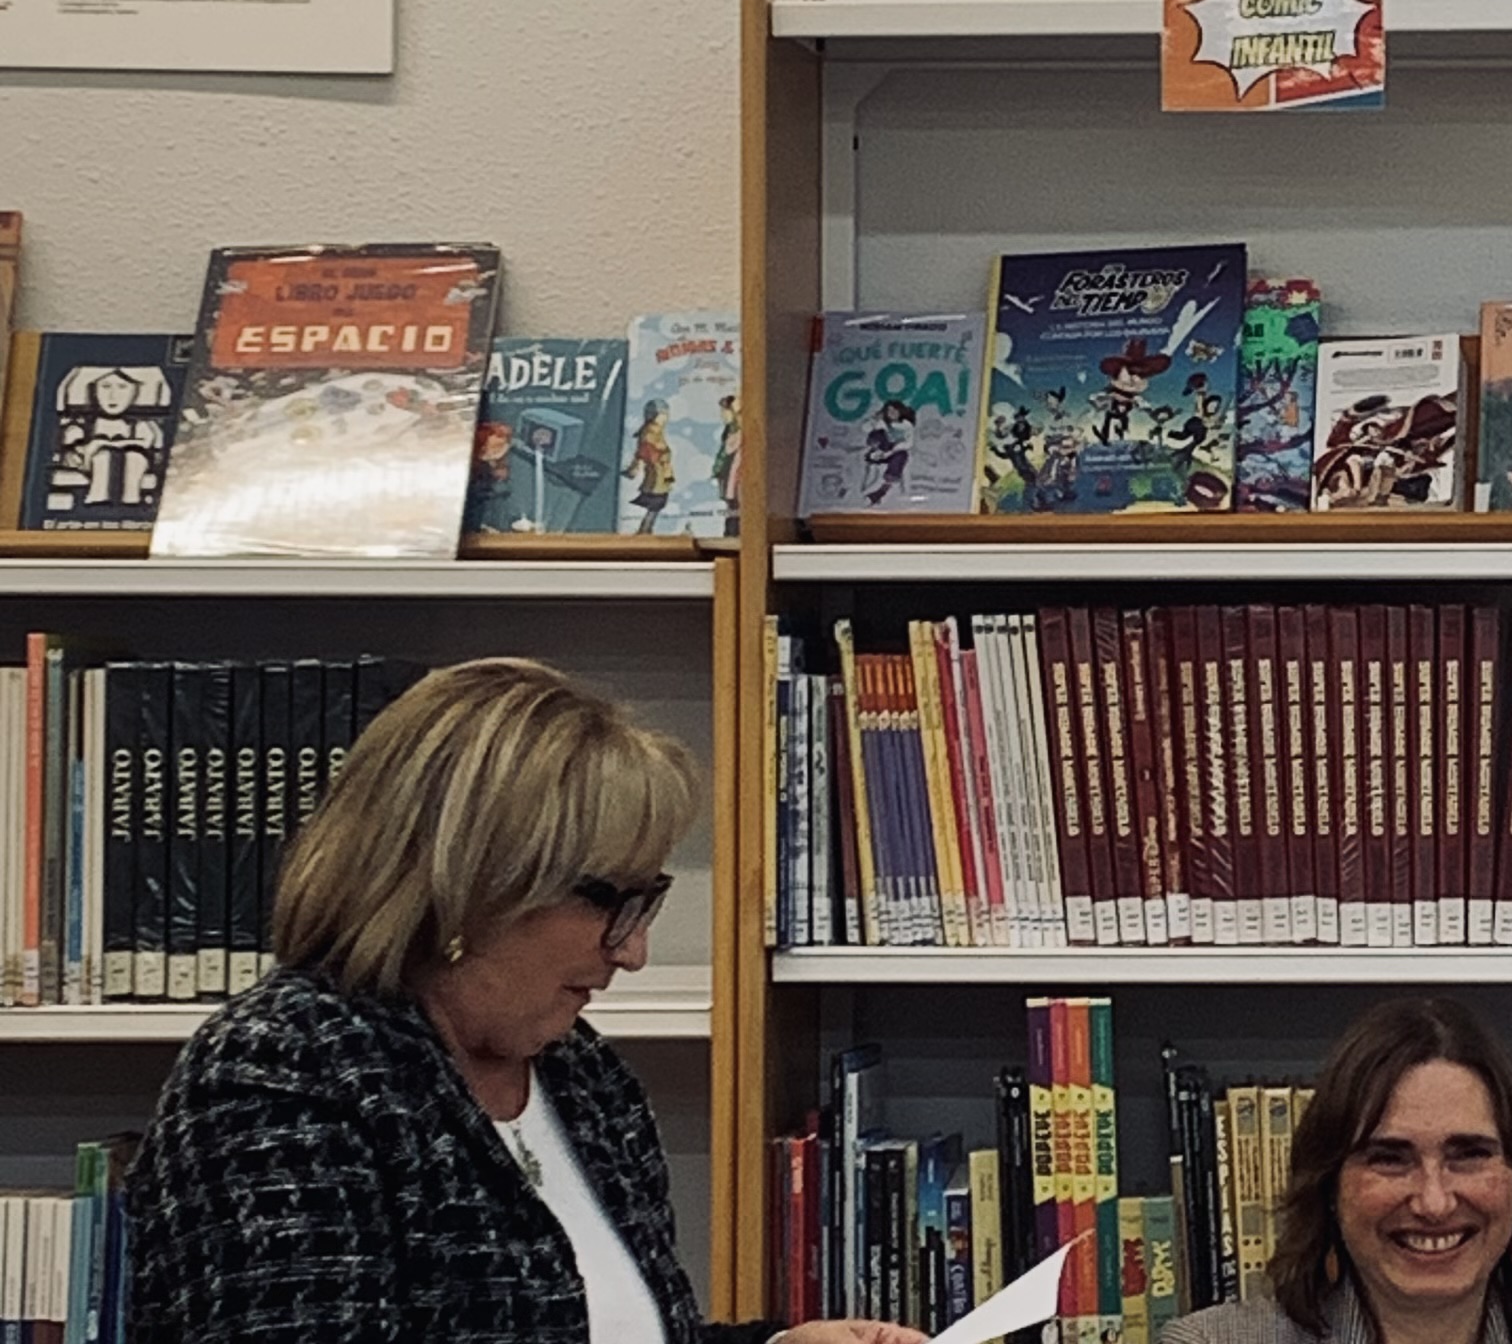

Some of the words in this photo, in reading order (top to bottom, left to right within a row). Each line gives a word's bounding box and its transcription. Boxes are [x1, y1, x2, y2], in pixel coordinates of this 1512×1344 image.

[1231, 29, 1336, 71] INFANTIL
[276, 283, 338, 302] LIBRO
[345, 283, 417, 301] JUEGO
[1059, 270, 1190, 293] FORASTEROS
[235, 325, 453, 353] ESPACIO
[824, 361, 971, 423] GOA!
[111, 749, 132, 843] JABATO
[177, 747, 198, 842] JABATO
[206, 747, 226, 842] JABATO
[236, 747, 257, 841] JABATO
[299, 747, 318, 824] ABATO
